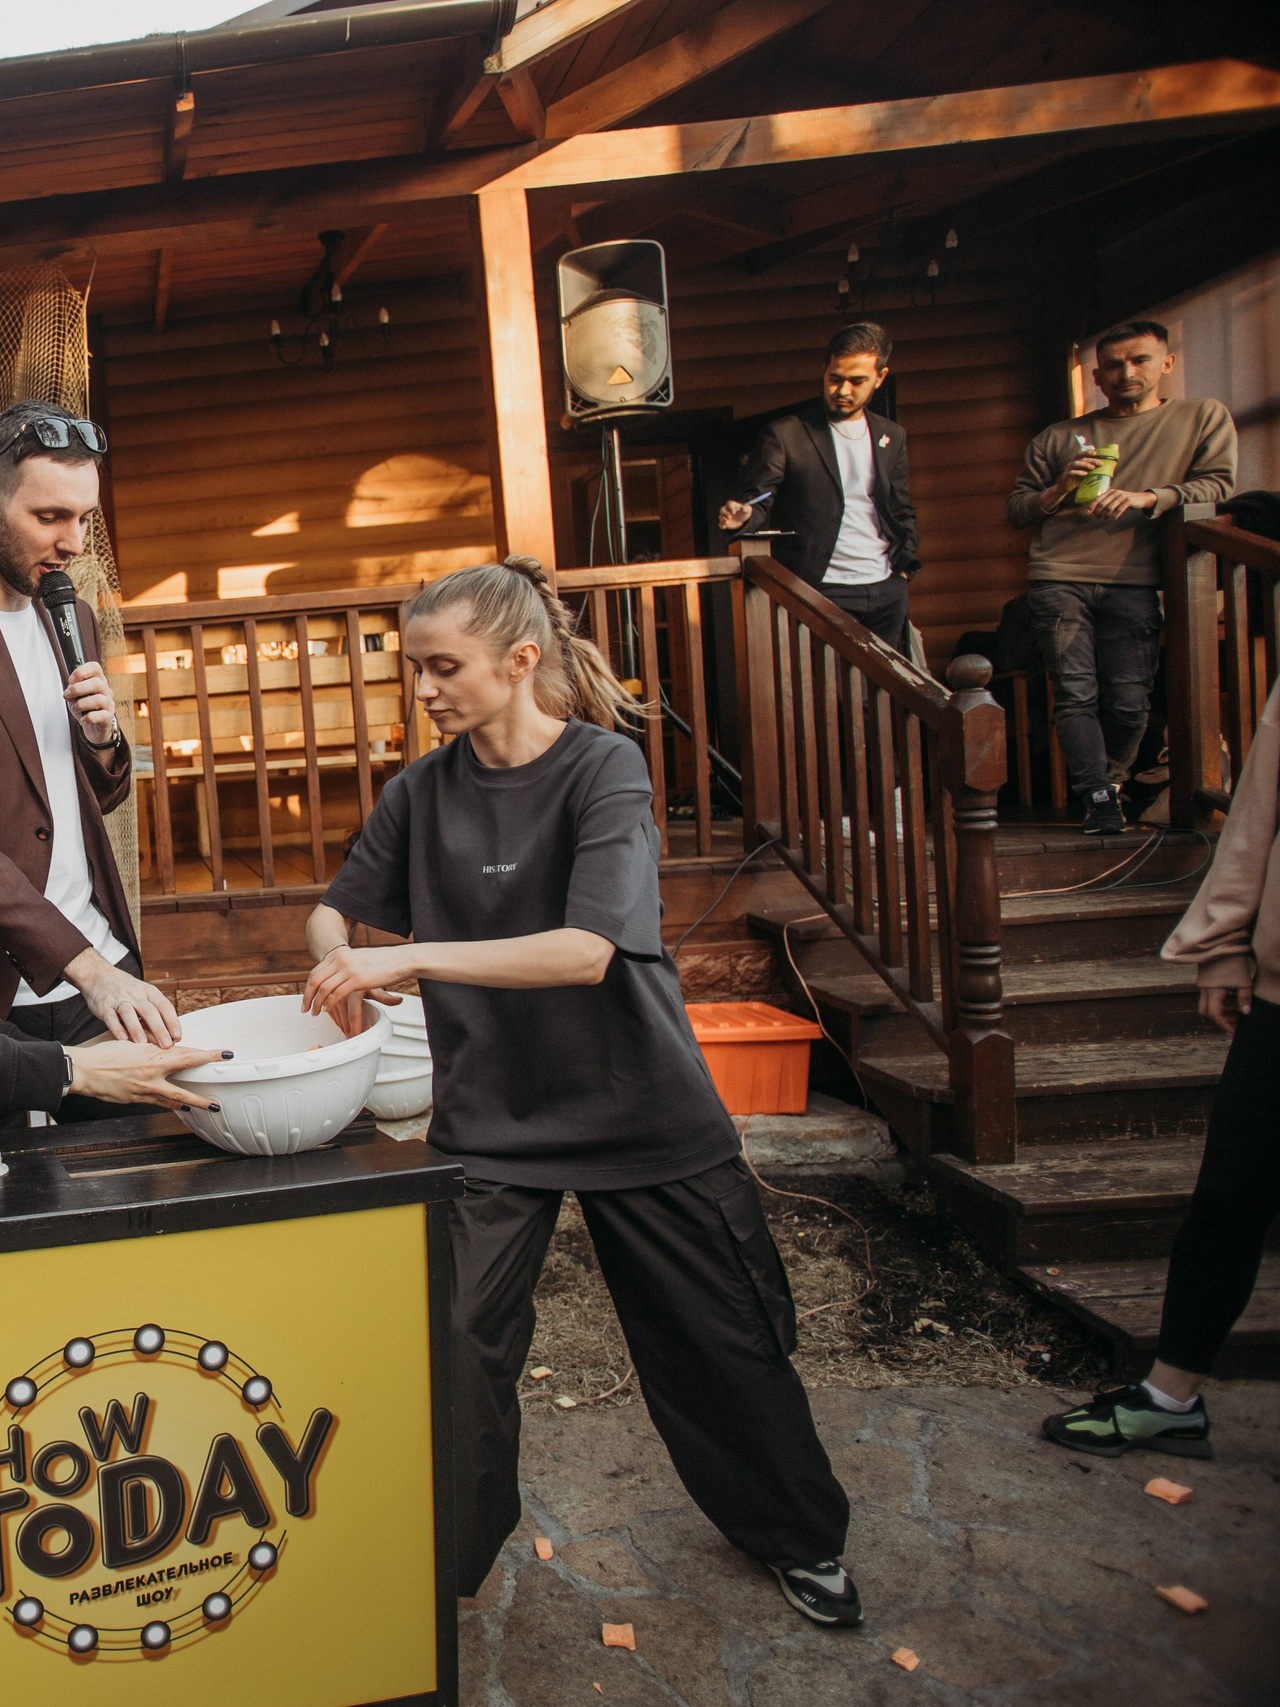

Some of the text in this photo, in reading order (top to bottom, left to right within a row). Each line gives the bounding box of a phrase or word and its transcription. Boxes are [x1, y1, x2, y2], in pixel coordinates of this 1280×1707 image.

[482, 863, 518, 873] HISTORY
[70, 1552, 233, 1606] РАЗВЛЕКАТЕЛЬНОЕ
[136, 1587, 174, 1607] ШОУ
